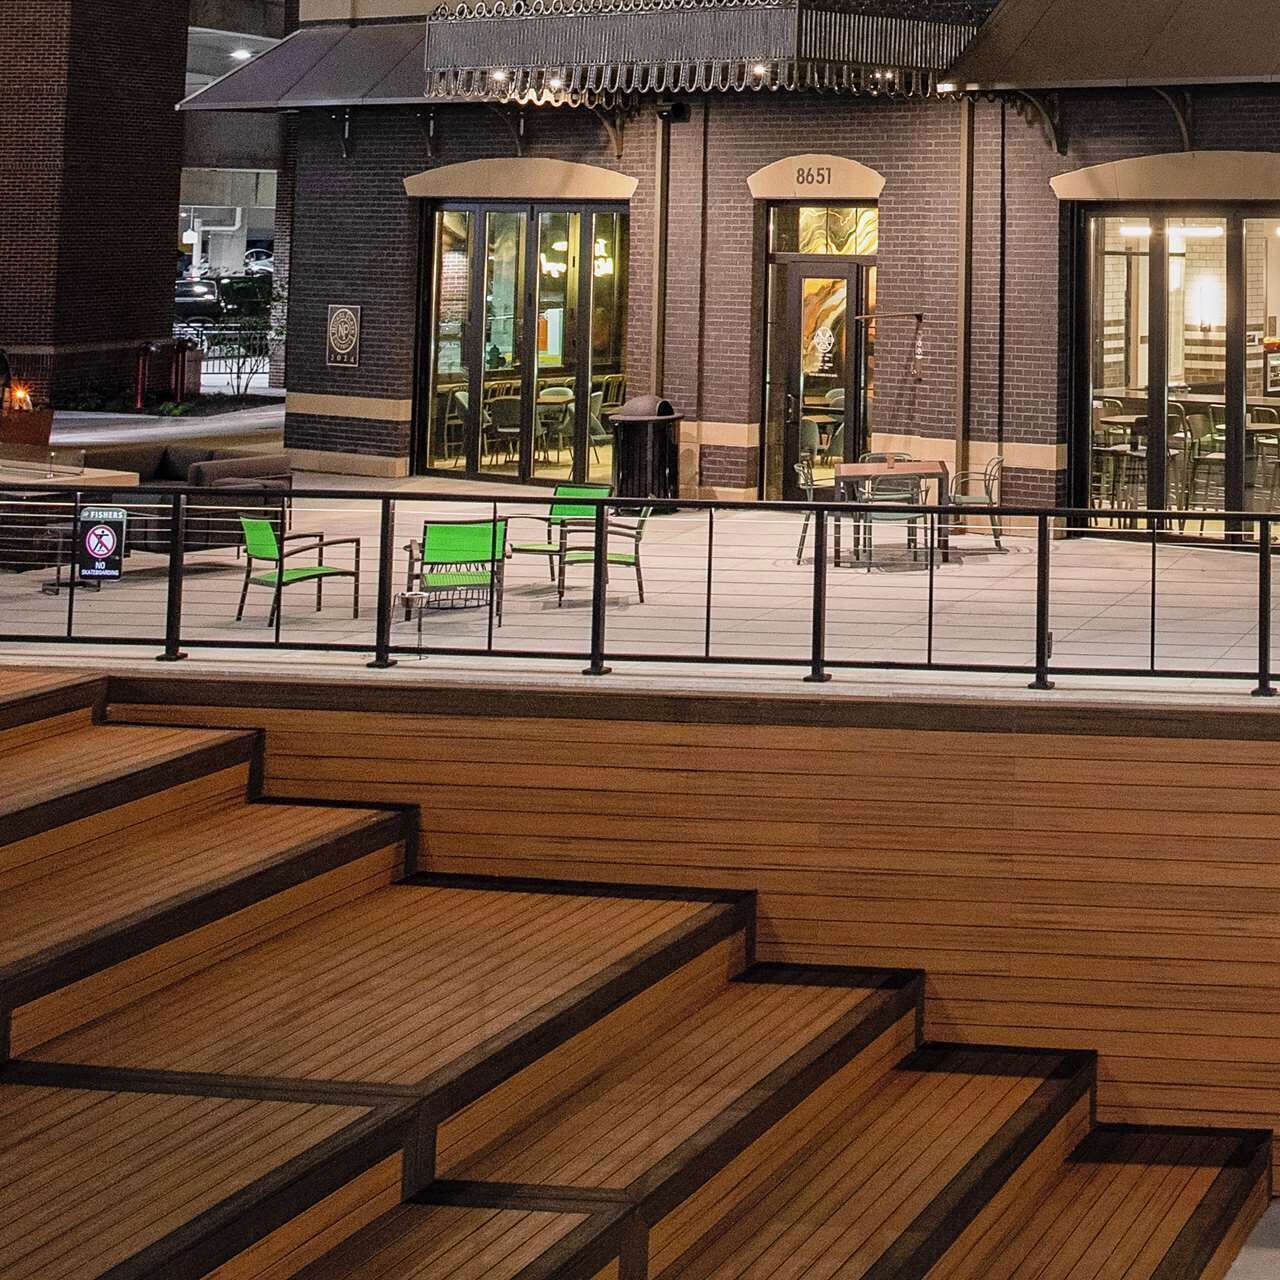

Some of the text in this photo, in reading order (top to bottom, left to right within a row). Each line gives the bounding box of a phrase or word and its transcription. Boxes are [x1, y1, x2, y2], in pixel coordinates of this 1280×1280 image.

[796, 167, 832, 185] 8651
[90, 510, 123, 519] FISHERS
[95, 561, 106, 569] NO
